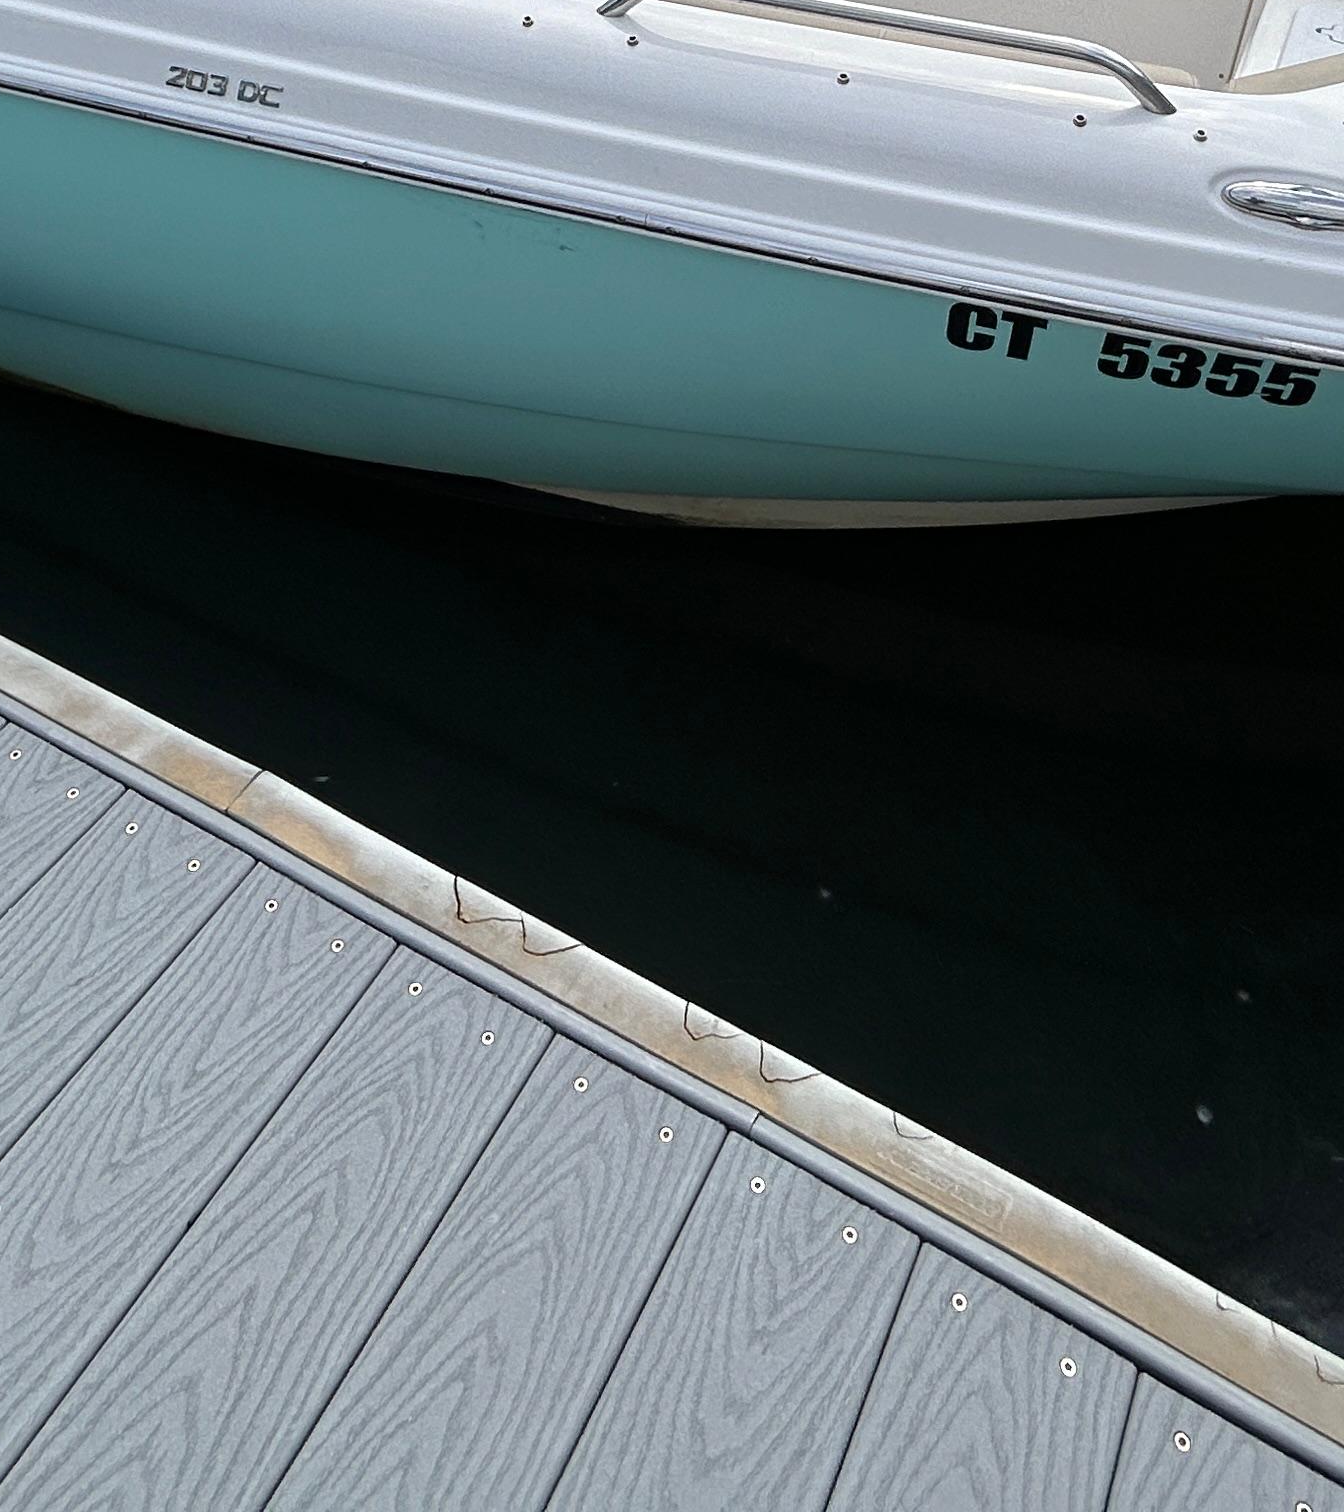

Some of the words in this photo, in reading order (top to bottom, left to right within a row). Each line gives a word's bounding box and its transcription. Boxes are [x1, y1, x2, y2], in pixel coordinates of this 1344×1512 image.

[165, 65, 229, 97] 203
[236, 79, 285, 109] DC
[945, 301, 1049, 361] CT
[1096, 332, 1321, 407] 5355
